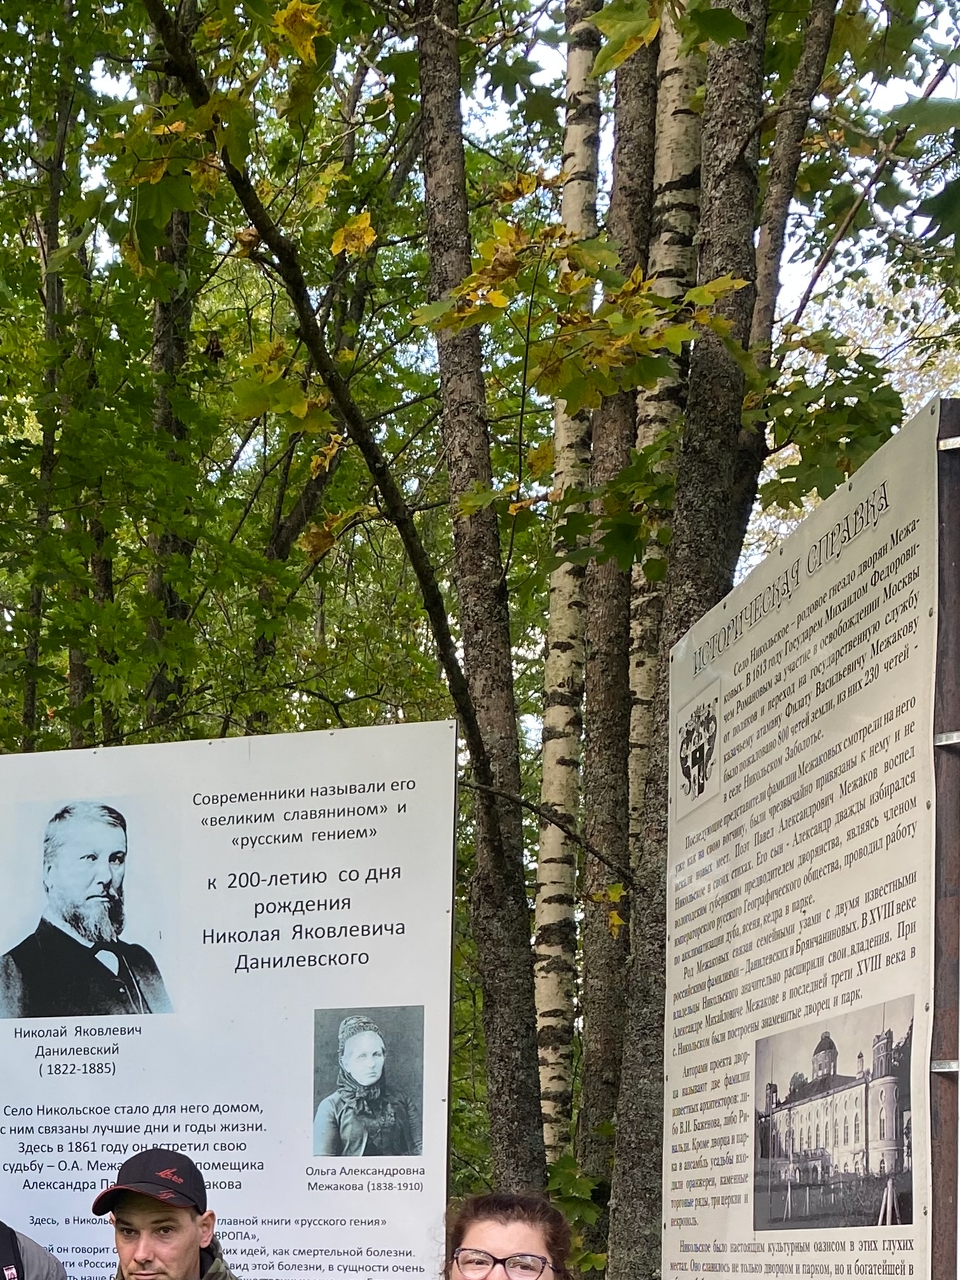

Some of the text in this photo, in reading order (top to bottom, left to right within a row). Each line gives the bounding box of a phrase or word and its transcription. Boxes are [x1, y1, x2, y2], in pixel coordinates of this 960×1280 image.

[692, 478, 891, 679] ИСТОРИЧЕСКАЯ СПРАВКА
[732, 517, 920, 678] Село Никольское родовое гнездо дворян Межа-
[783, 616, 824, 657] Государем
[869, 542, 920, 588] Федорови-
[819, 564, 921, 651] освобождении Москвы
[809, 588, 921, 681] государственную службу
[784, 690, 814, 719] Филату
[869, 614, 920, 660] Межакову
[191, 779, 417, 808] Современники называли его
[868, 769, 917, 807] избирался
[200, 803, 389, 828] «великим славянином»
[231, 827, 378, 851] «русским гением»
[226, 865, 402, 890] 200-летию со дня
[253, 896, 352, 920] рождения
[202, 921, 406, 945] Николая Яковлевича
[233, 951, 370, 975] Данилевского
[13, 1024, 142, 1039] Николай Яковлевич
[33, 1042, 120, 1060] Данилевский
[46, 1061, 117, 1077] 1822-1885)
[2, 1103, 264, 1118] Село Никольское стало для него домом,
[9, 1122, 268, 1137] ним связаны лучшие дни годы жизни.
[17, 1140, 248, 1156] Здесь 1861 году свою
[1, 1158, 45, 1175] судьбу
[57, 1159, 84, 1172] О.А.
[195, 1160, 265, 1176] помещика
[305, 1165, 426, 1178] Ольга Александровна
[21, 1178, 97, 1193] Александра
[307, 1181, 364, 1192] Межакова
[366, 1180, 424, 1194] (1838-1910)
[28, 1214, 60, 1227] Здесь,
[216, 1215, 388, 1229] главной книги «русского гения»
[239, 1245, 413, 1259] идей, смертельной болезни.
[857, 1238, 915, 1256] этих глухих
